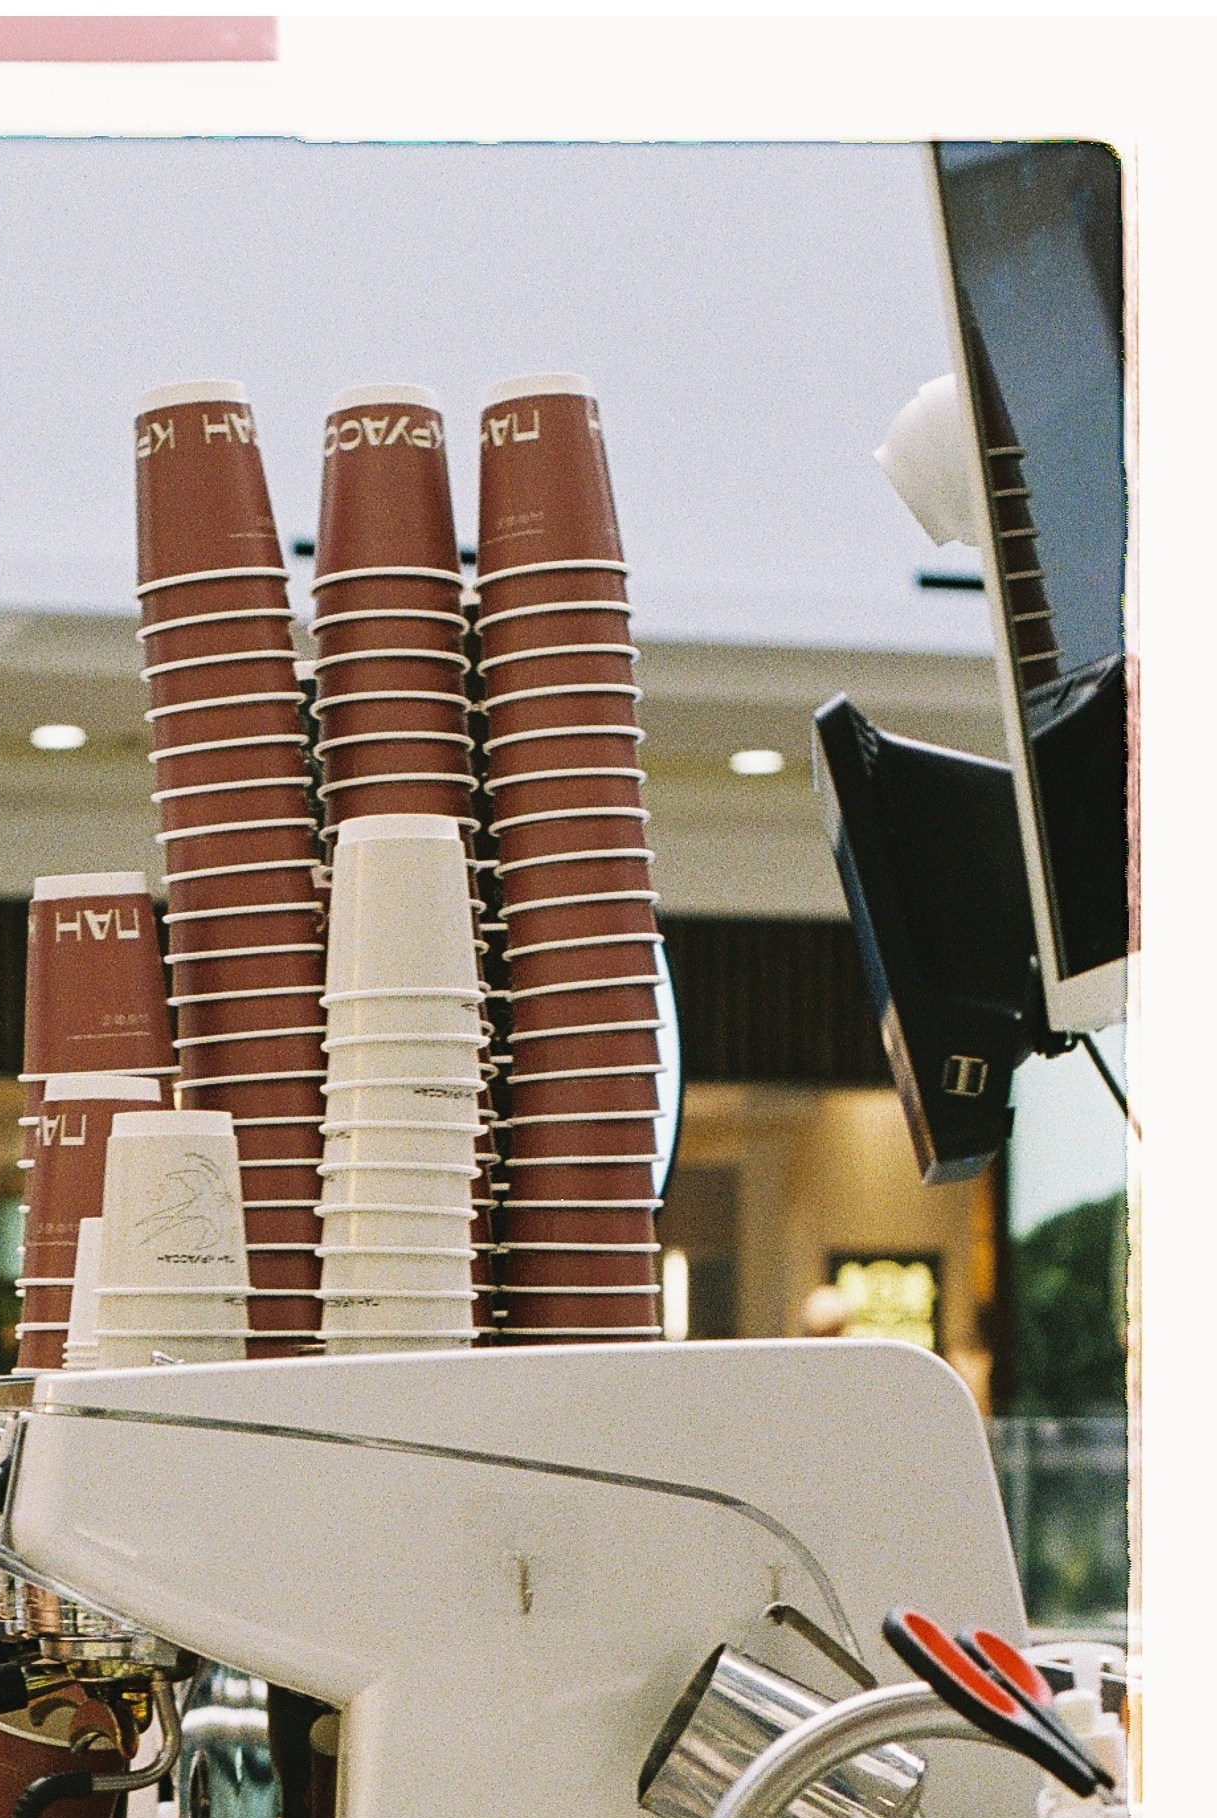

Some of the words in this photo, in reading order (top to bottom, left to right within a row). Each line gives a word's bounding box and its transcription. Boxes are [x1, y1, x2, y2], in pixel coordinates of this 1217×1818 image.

[480, 408, 540, 447] ПА
[54, 907, 140, 942] ПАН
[35, 1114, 87, 1146] ПА
